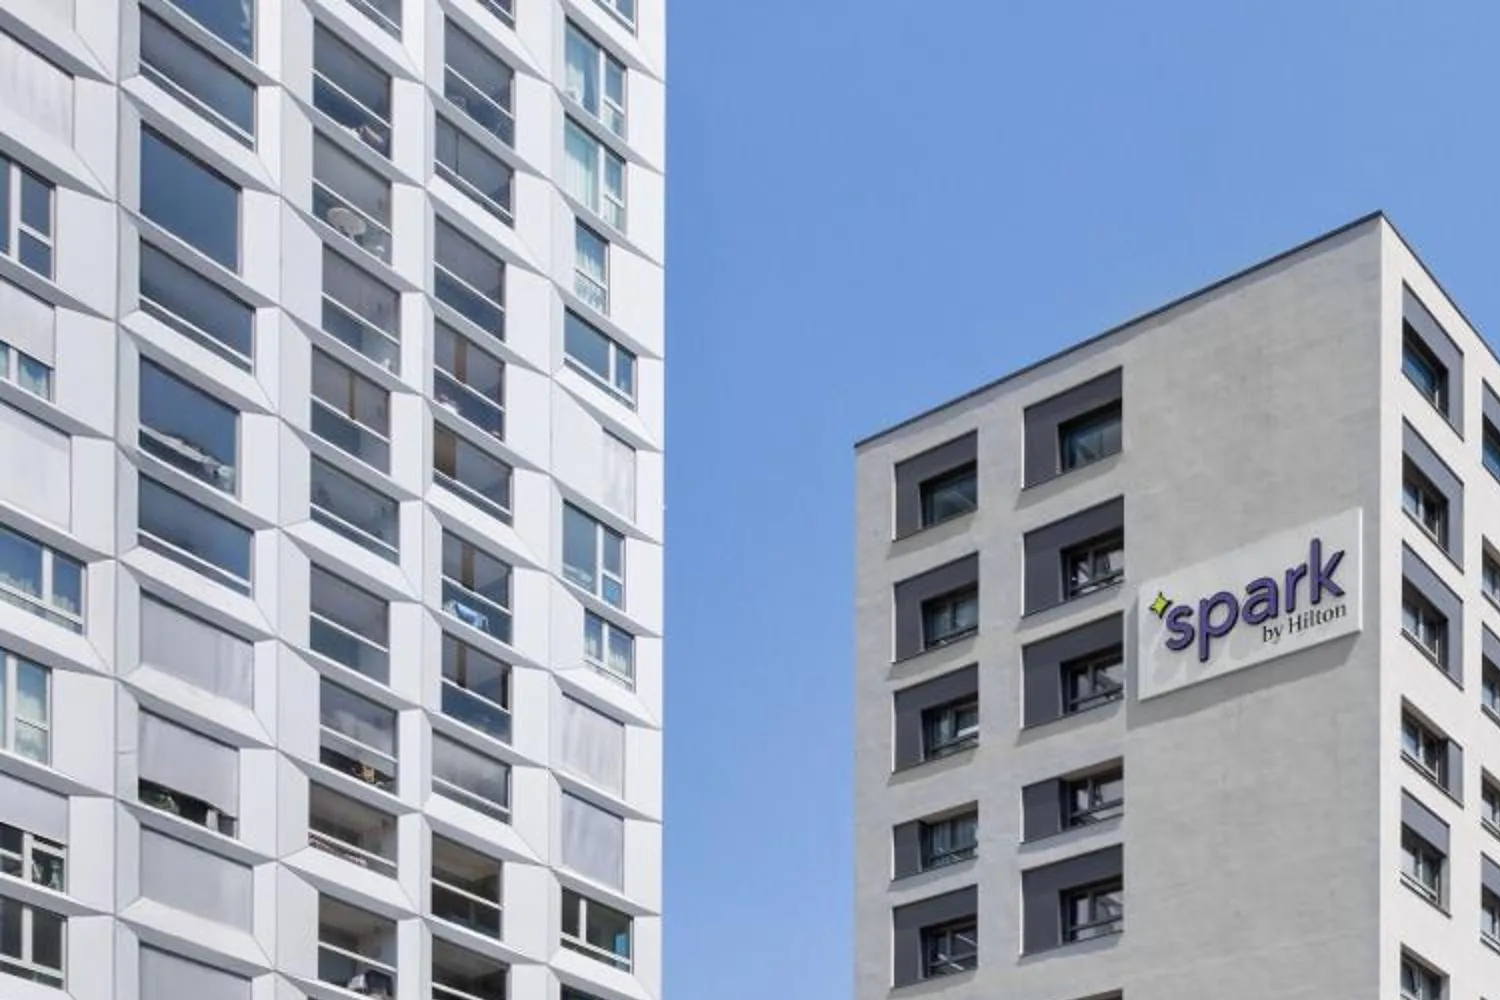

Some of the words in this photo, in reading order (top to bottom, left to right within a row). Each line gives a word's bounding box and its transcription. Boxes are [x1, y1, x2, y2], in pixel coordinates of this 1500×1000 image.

[1165, 537, 1346, 663] spark
[1263, 625, 1284, 645] by
[1288, 603, 1347, 635] Hilton
